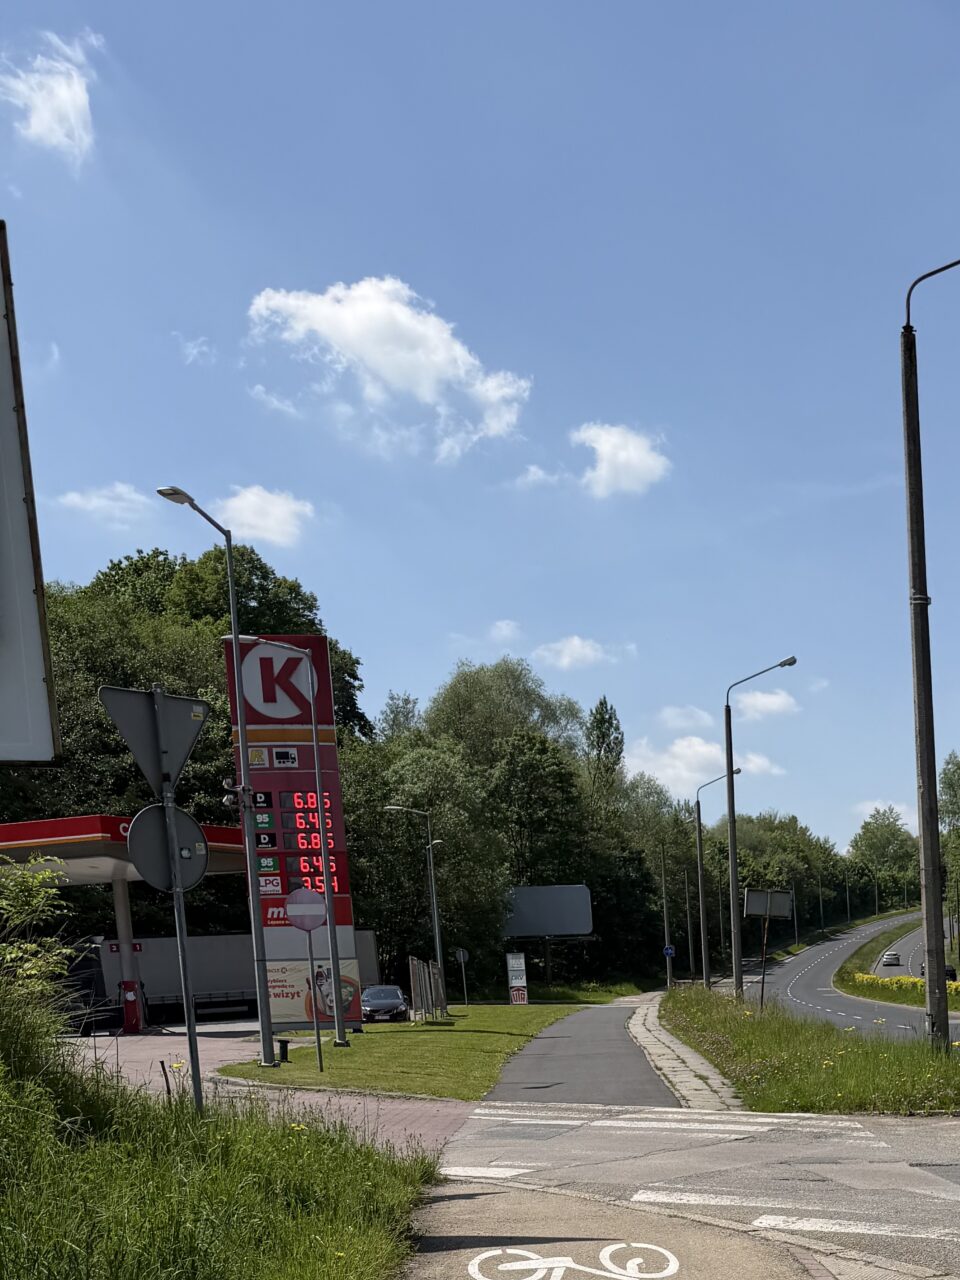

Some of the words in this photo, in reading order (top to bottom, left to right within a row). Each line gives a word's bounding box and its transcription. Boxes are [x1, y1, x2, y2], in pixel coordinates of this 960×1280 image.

[256, 793, 265, 802] D
[256, 814, 269, 822] 95
[260, 835, 269, 843] D
[260, 858, 274, 866] 95
[258, 878, 280, 888] LPG
